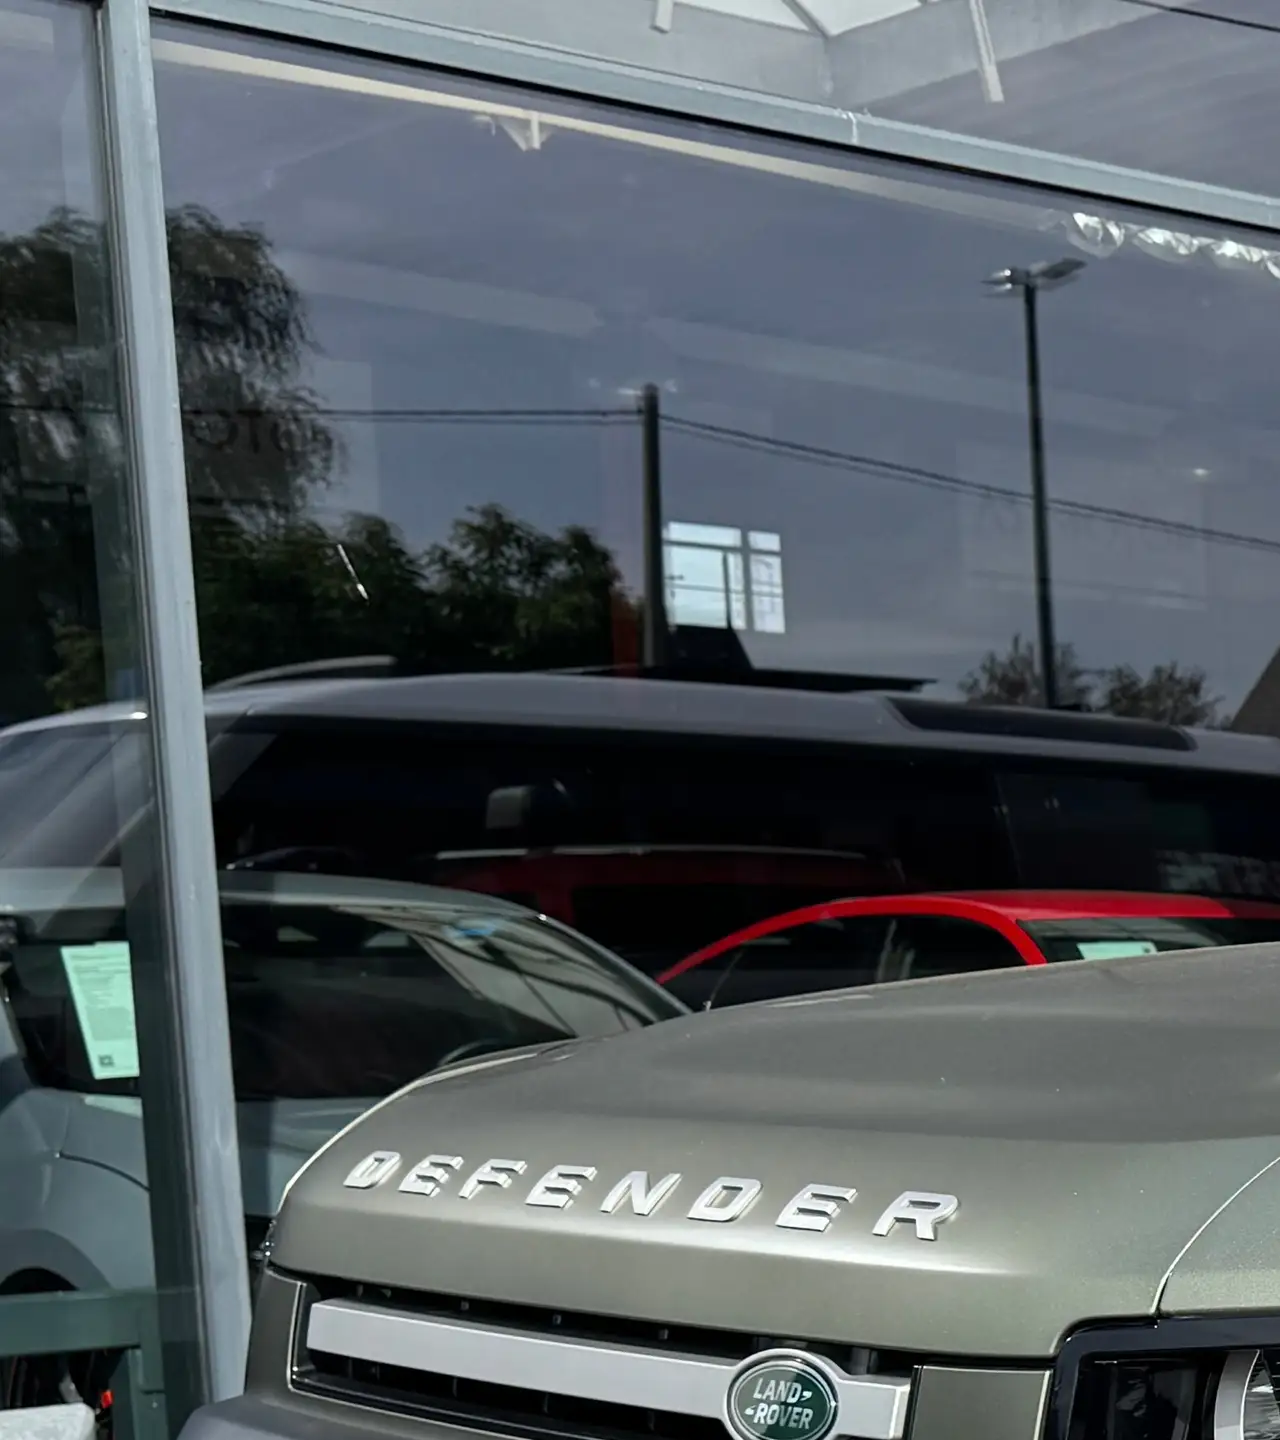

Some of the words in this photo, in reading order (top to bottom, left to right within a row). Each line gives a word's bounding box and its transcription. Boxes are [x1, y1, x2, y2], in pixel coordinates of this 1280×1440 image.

[343, 1149, 960, 1241] DEFENDER
[752, 1377, 803, 1404] LAND
[752, 1402, 814, 1430] ROVER
